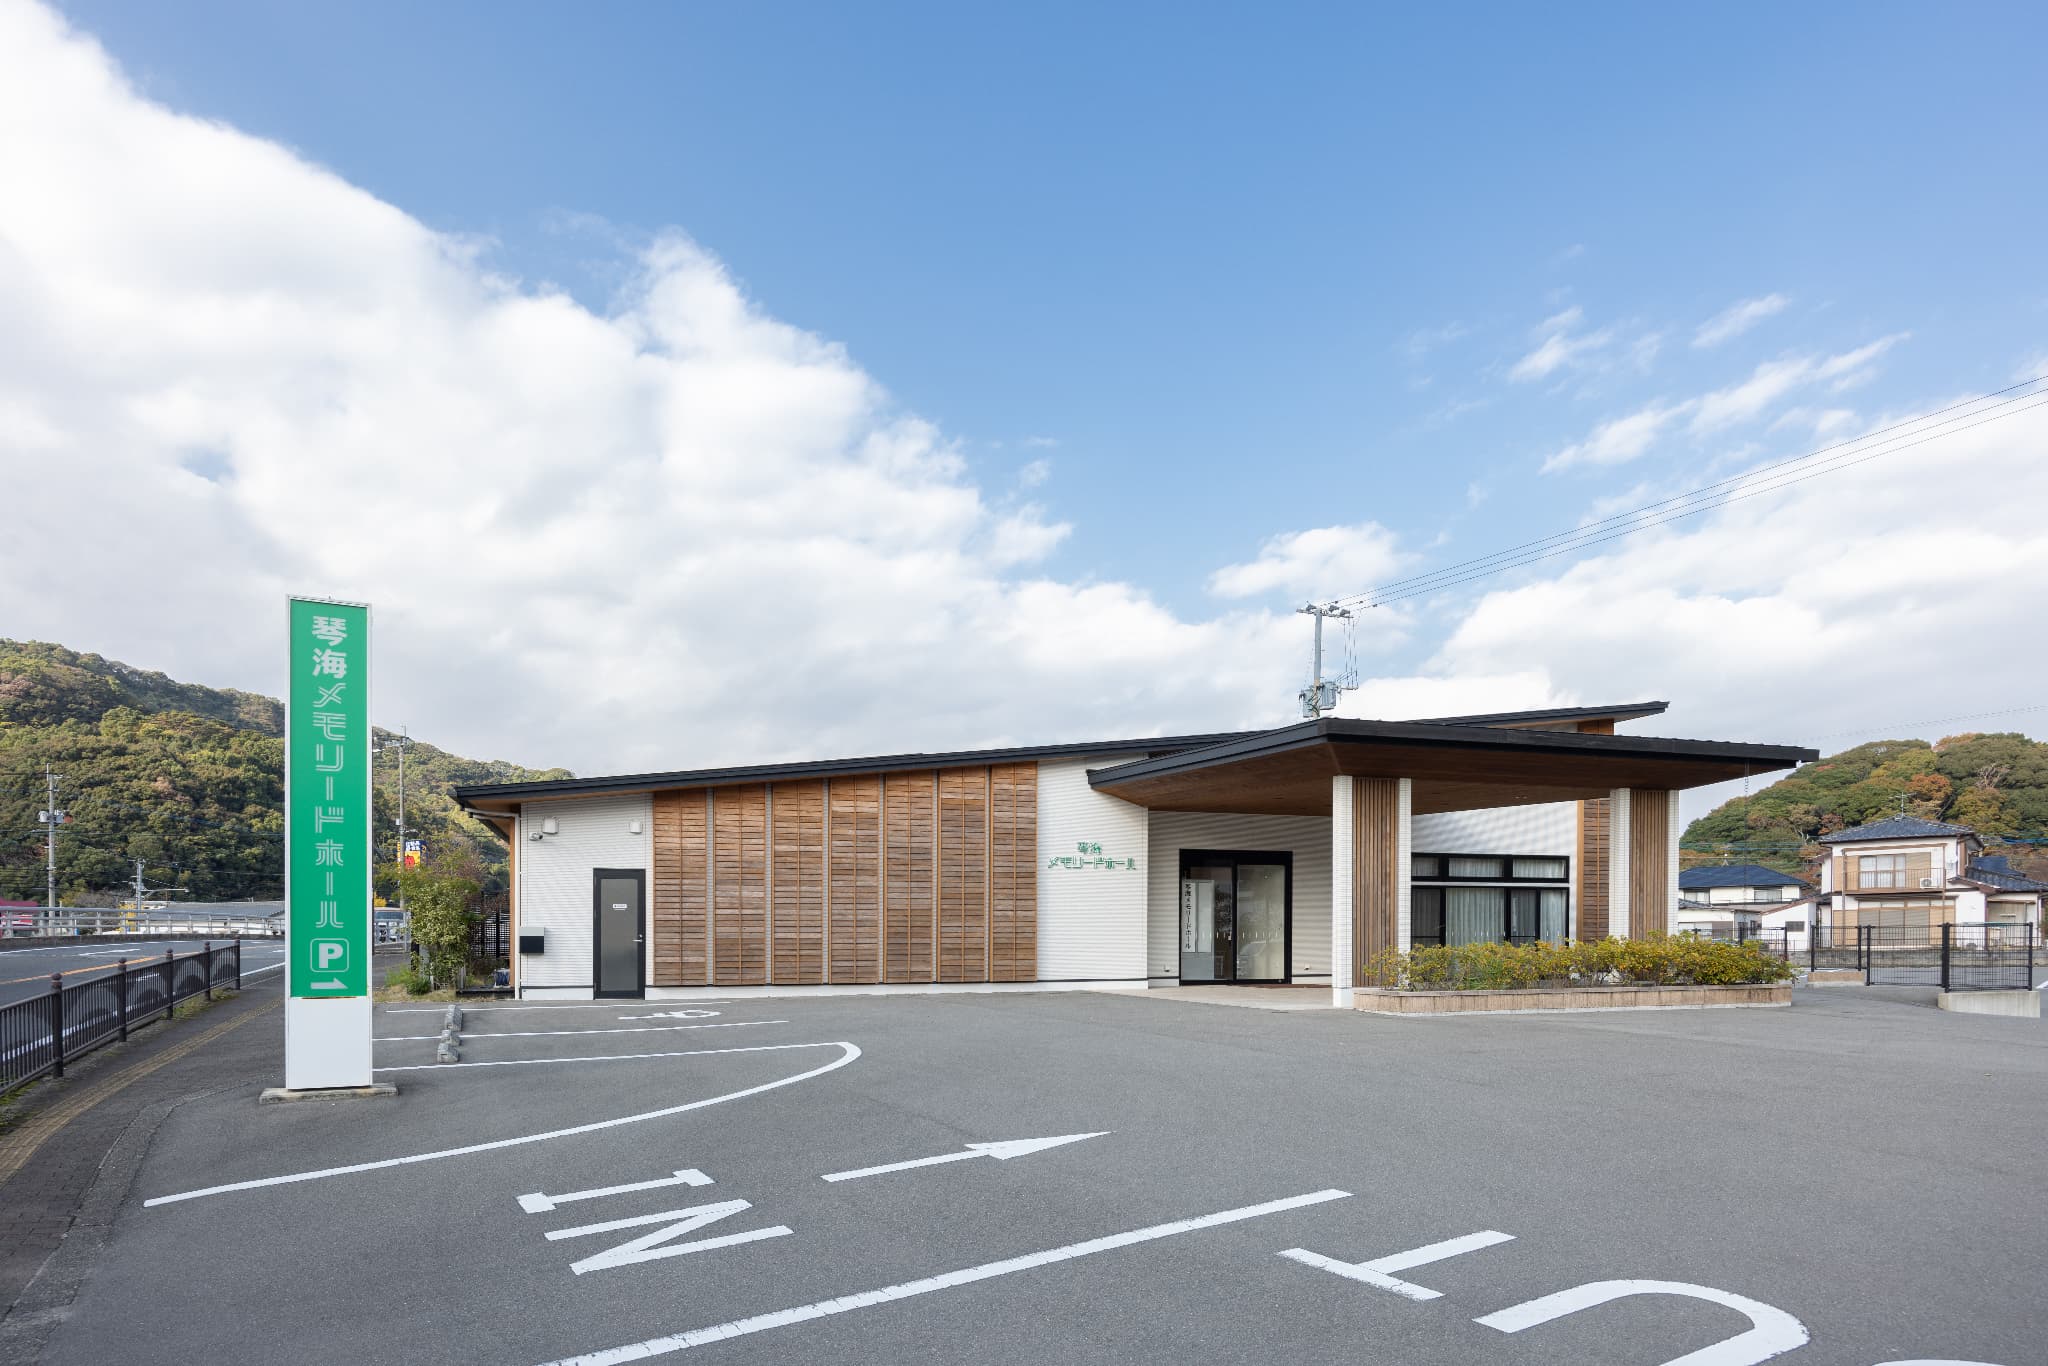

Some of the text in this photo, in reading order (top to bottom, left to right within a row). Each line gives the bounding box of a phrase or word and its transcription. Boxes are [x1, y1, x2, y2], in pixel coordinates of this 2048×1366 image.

[312, 615, 348, 928] 琴海メモリードホール
[318, 943, 344, 968] P
[516, 1168, 794, 1275] IN
